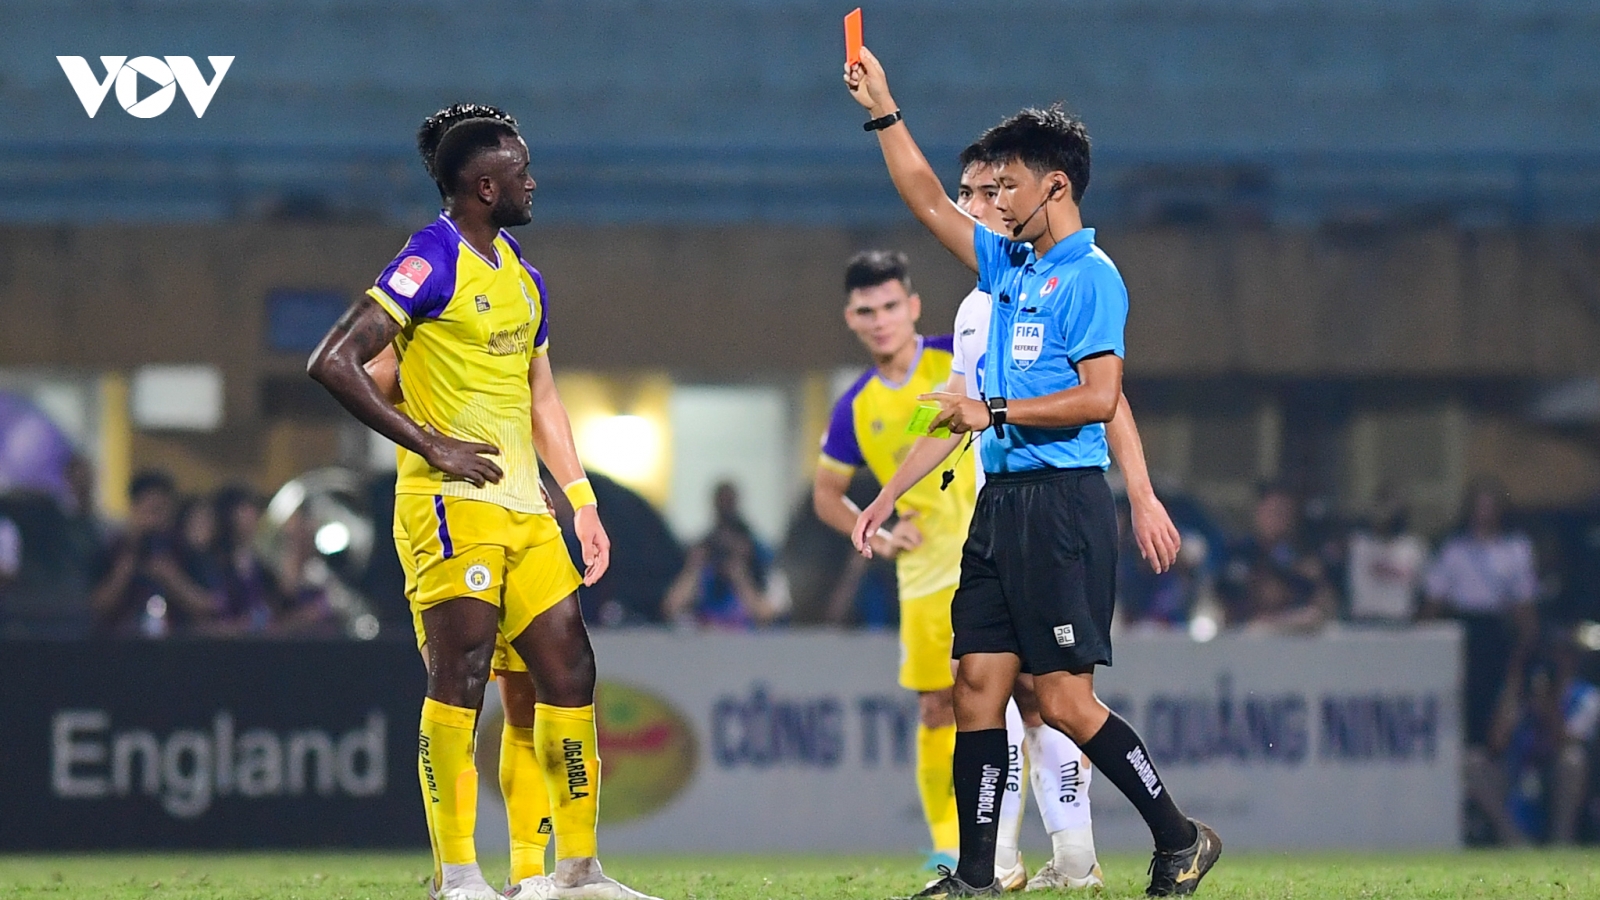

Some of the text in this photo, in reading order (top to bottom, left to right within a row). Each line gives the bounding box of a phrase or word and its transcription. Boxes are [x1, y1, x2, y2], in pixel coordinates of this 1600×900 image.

[1014, 344, 1038, 352] REFEREE
[1016, 326, 1039, 338] FIFA
[51, 709, 388, 818] England
[562, 738, 589, 800] JOGARBOLA
[1006, 744, 1021, 792] mitre
[1059, 760, 1084, 804] mitre
[1126, 745, 1163, 800] JOGARBOLA
[976, 764, 1001, 825] JOGARBOLA
